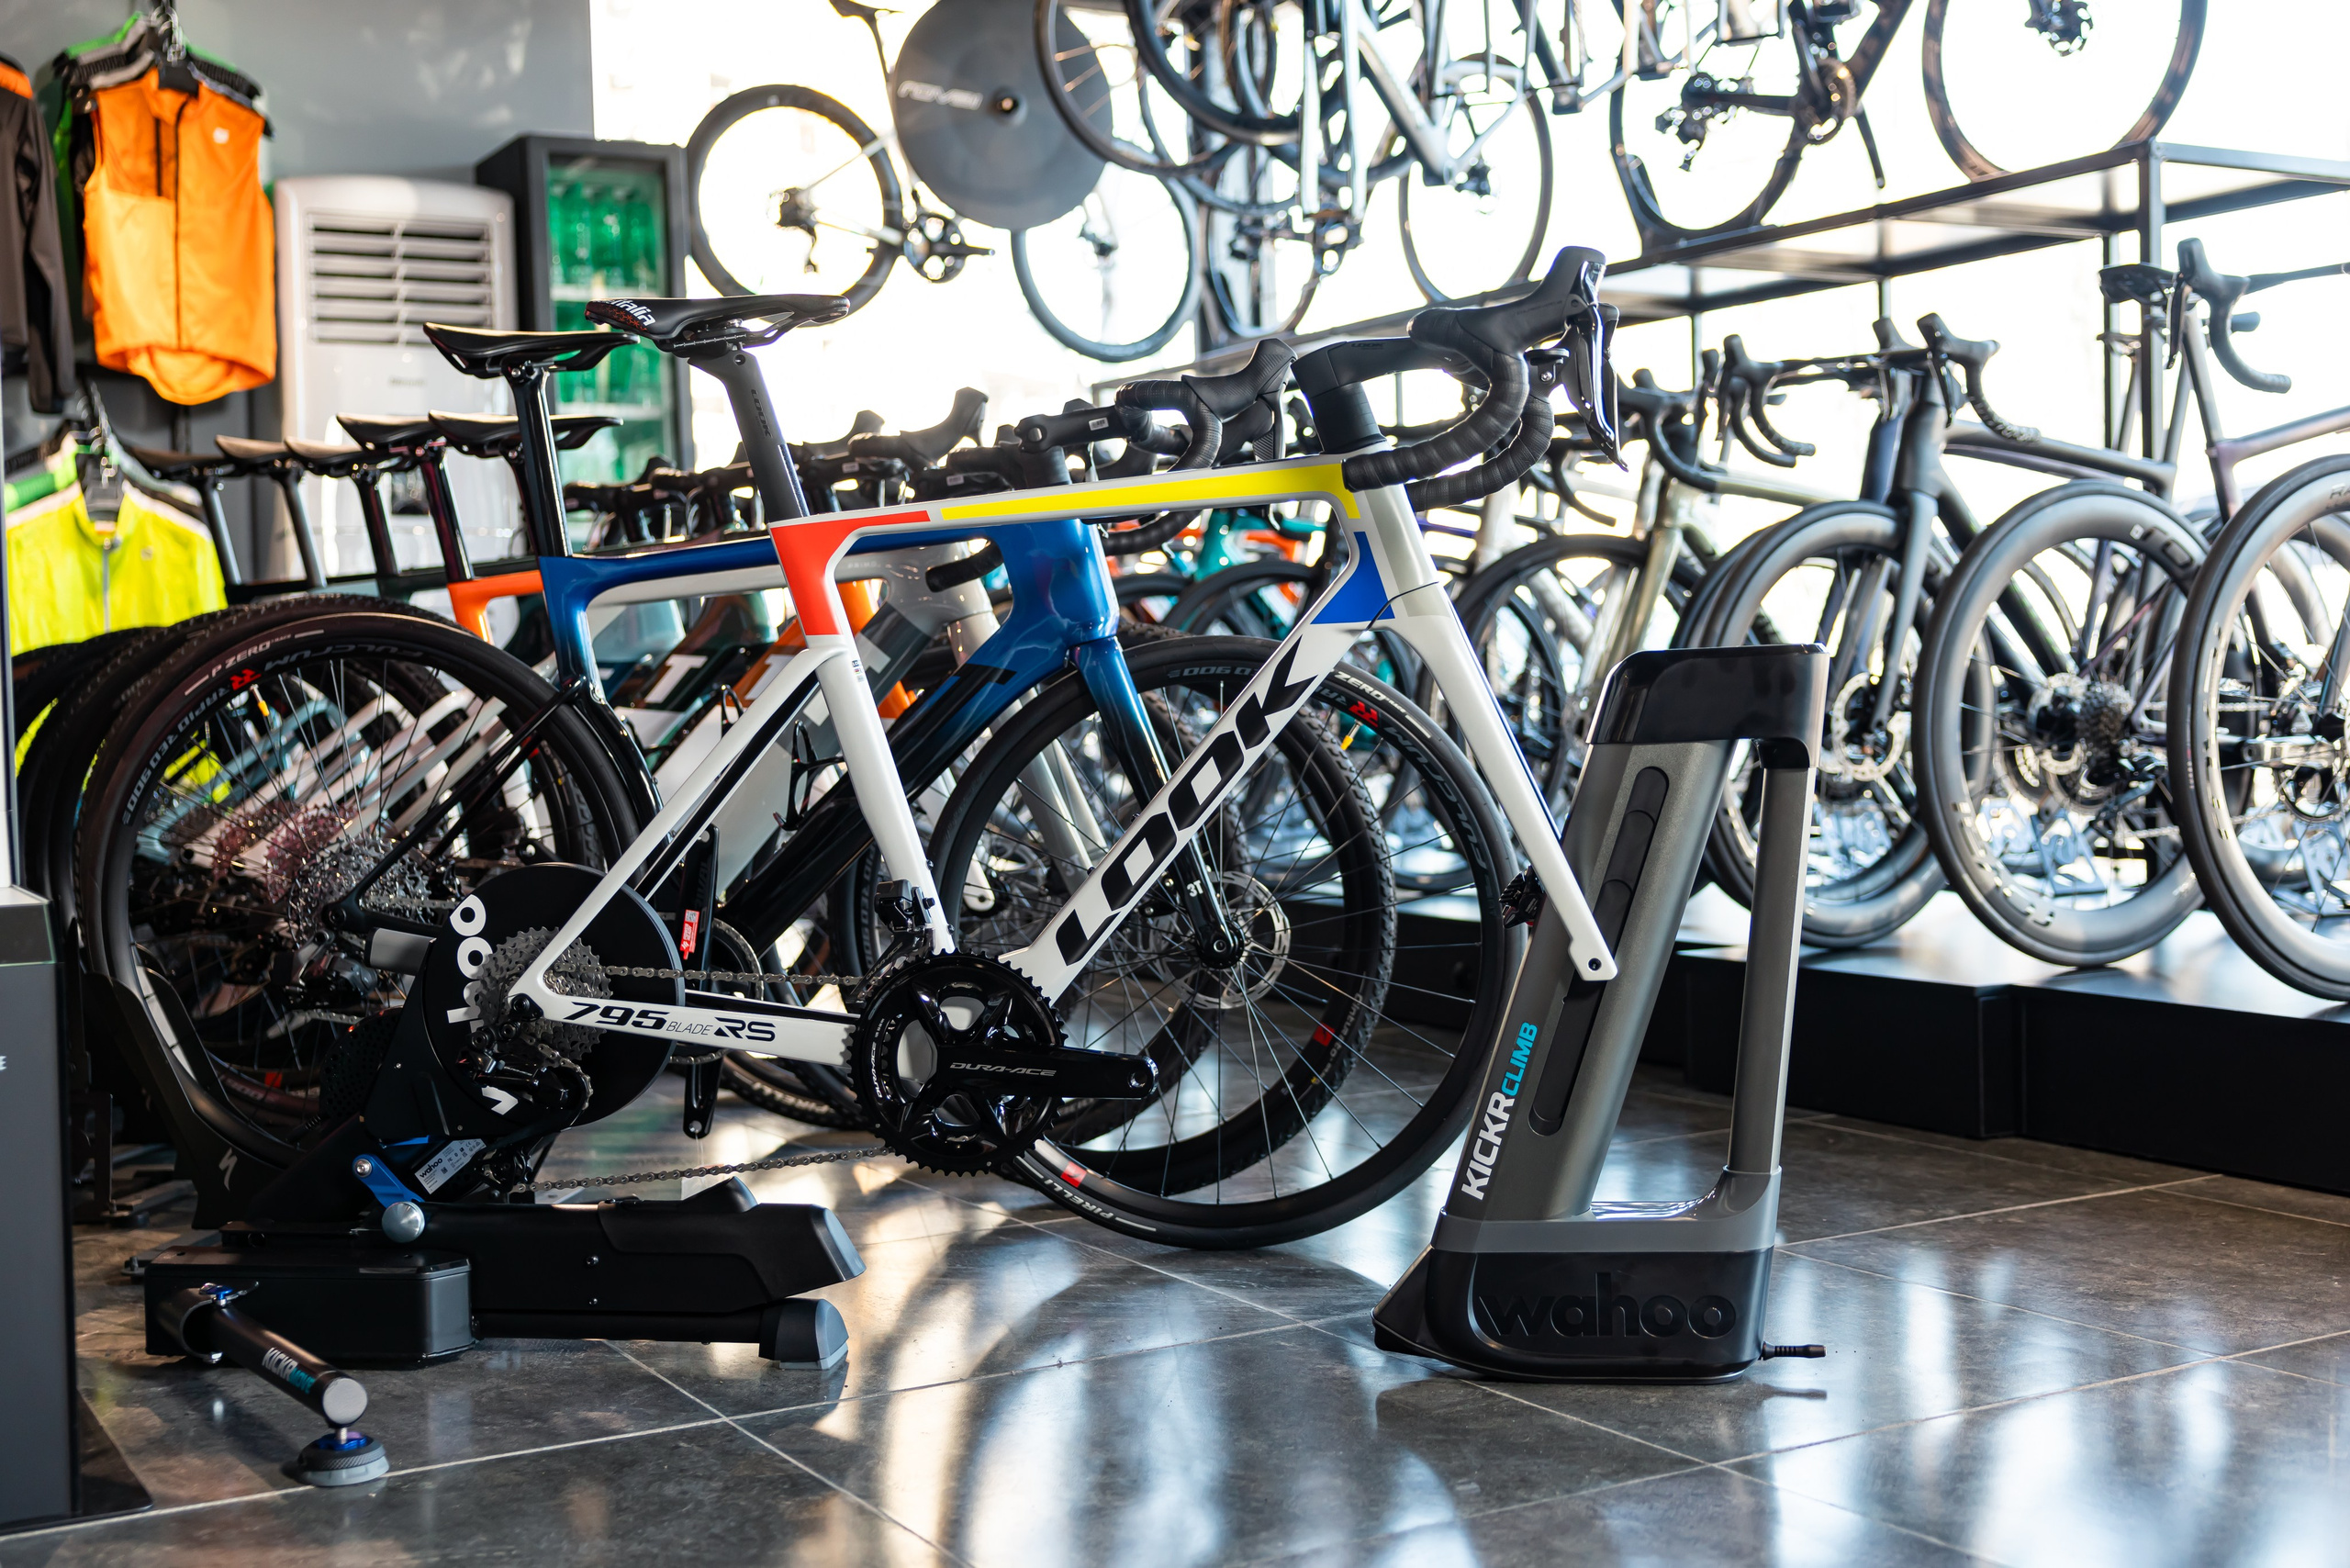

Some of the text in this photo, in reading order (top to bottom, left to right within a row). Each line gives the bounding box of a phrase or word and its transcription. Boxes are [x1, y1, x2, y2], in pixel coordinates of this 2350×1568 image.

[750, 388, 773, 439] LOOK
[225, 640, 271, 670] ZERO
[1181, 666, 1232, 677] 900
[1334, 671, 1386, 702] ZERO
[127, 767, 152, 813] 900
[1056, 633, 1318, 967] LOOK
[1186, 879, 1204, 898] 3T
[563, 1002, 777, 1043] 795 BLADE RS
[950, 1062, 1058, 1077] DURA-ACE
[1461, 1022, 1539, 1201] KICKR CLIMB
[419, 1158, 443, 1178] wahoo
[1043, 1179, 1114, 1219] PIRELLI
[1478, 1271, 1737, 1340] wahoo
[262, 1347, 298, 1383] KICKR
